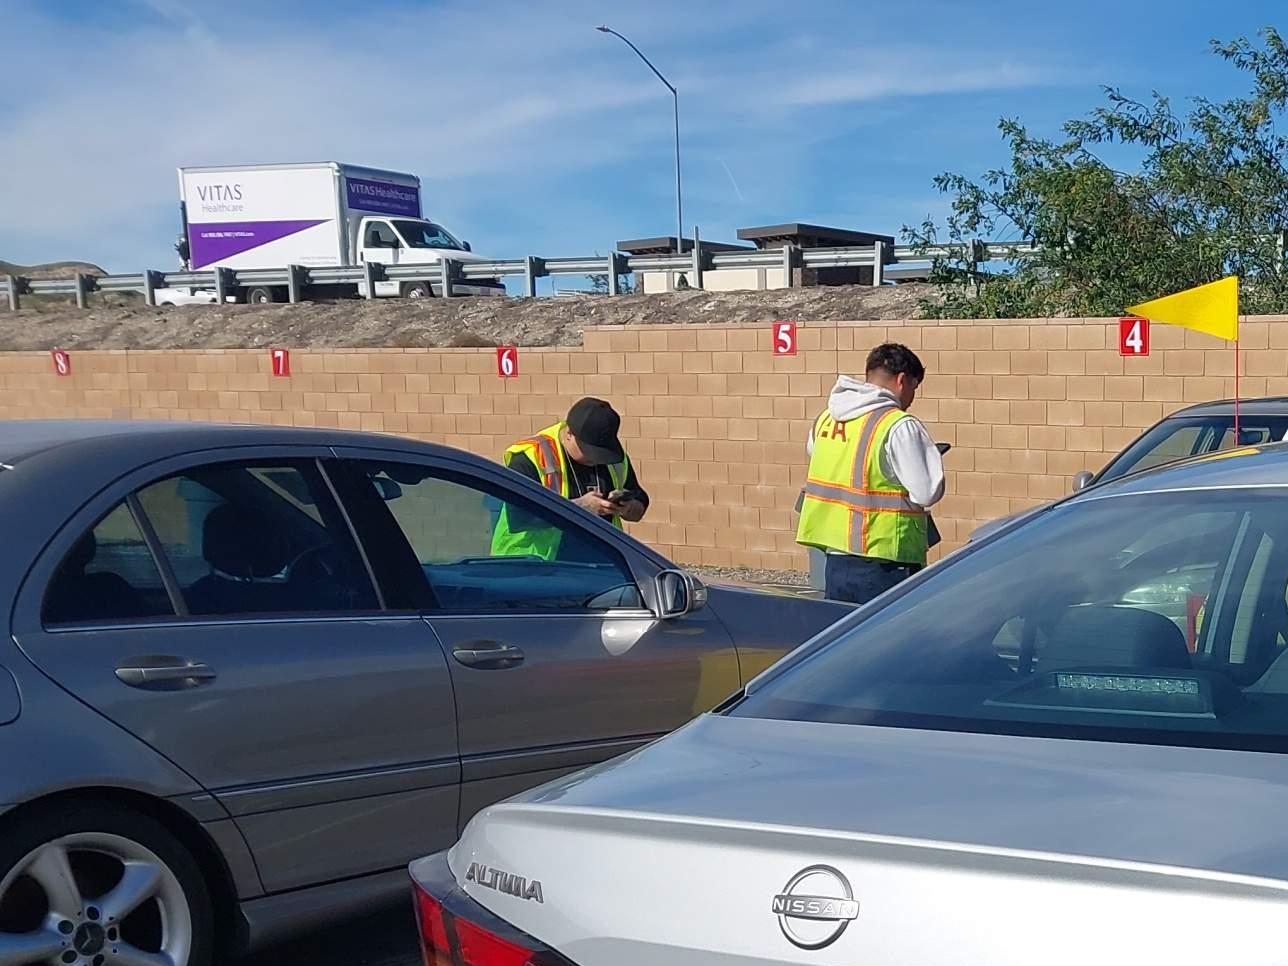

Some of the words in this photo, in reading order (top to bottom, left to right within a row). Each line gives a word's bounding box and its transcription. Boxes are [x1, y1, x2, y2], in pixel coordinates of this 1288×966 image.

[197, 184, 242, 201] VITAS
[202, 203, 244, 213] Healthcare
[777, 324, 792, 353] 5
[1125, 320, 1144, 353] 4
[55, 352, 67, 374] 8
[274, 351, 284, 375] 7
[502, 349, 514, 375] 6
[465, 862, 544, 904] ALTIMA
[772, 897, 855, 917] NISSAN
